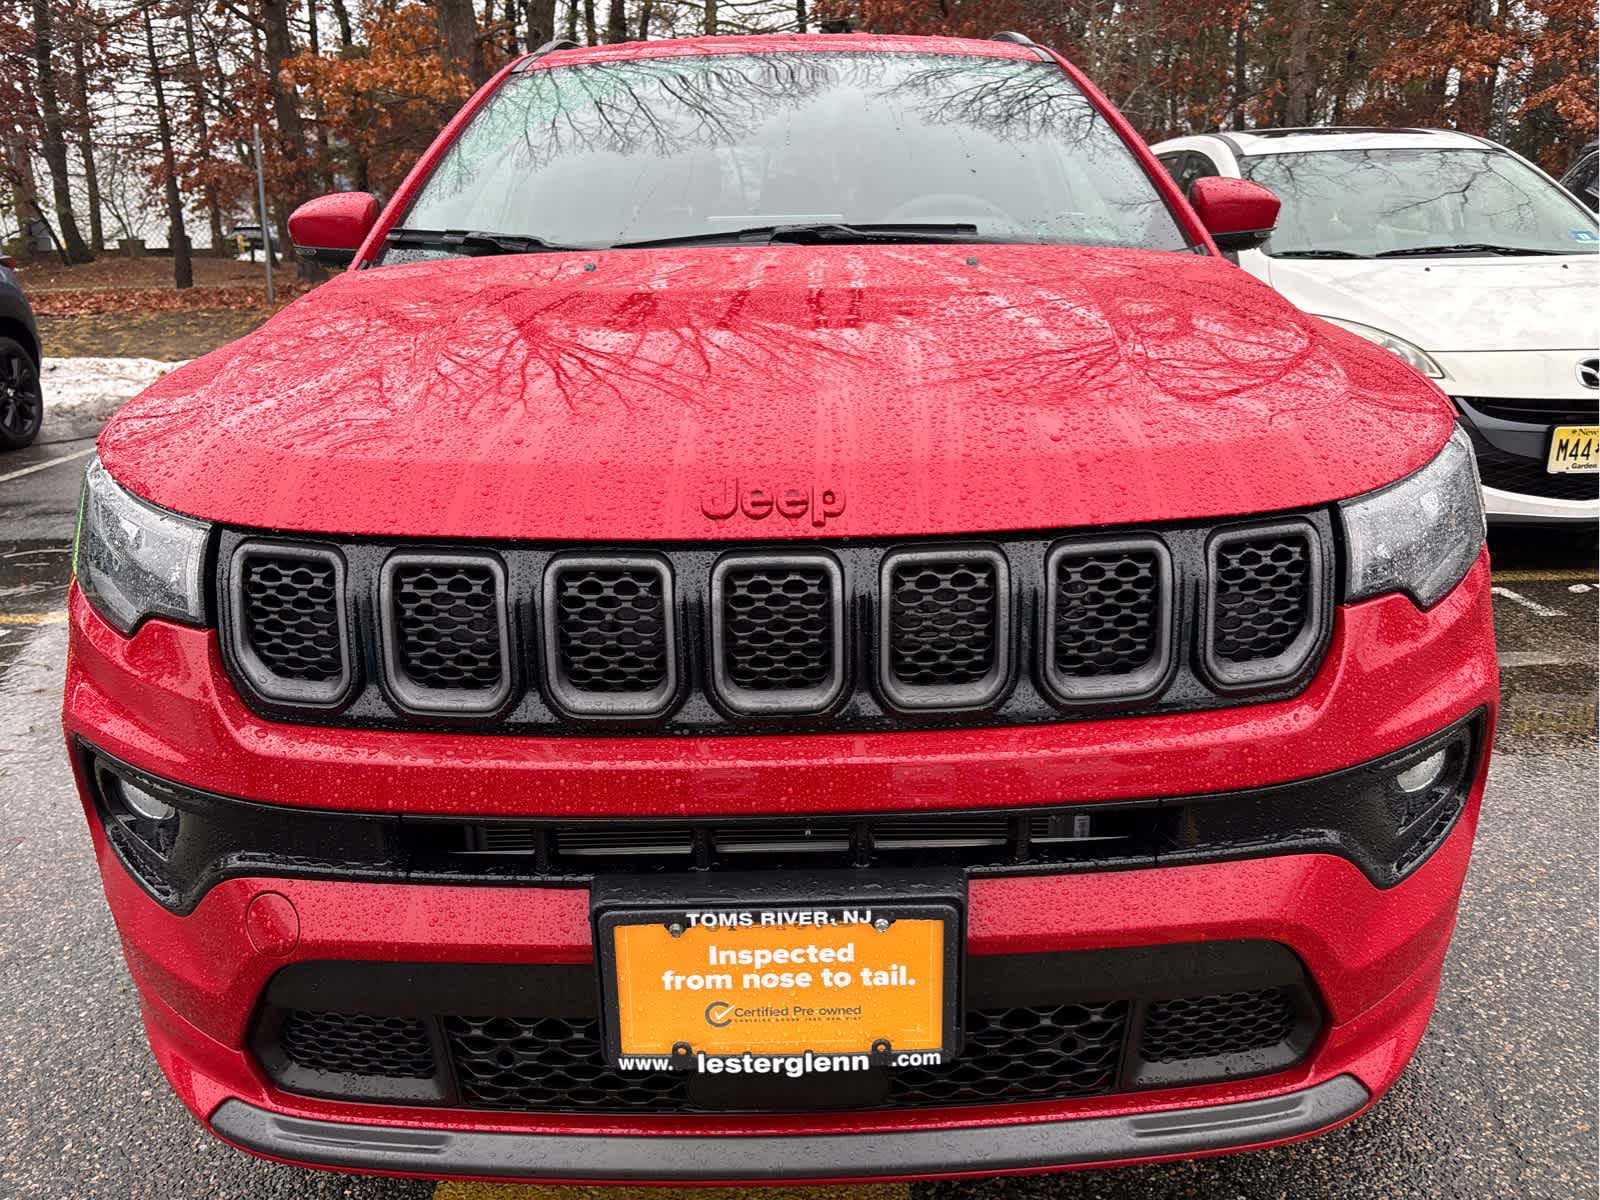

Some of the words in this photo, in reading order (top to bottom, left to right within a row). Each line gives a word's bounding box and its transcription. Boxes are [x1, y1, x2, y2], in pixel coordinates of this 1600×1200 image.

[701, 476, 846, 527] Jeep
[686, 912, 753, 928] TOMS
[843, 910, 872, 925] NJ
[708, 943, 855, 969] Inspected
[661, 970, 733, 990] from
[742, 971, 813, 989] nose
[821, 968, 852, 988] to
[860, 964, 917, 987] tail.
[734, 1006, 789, 1018] Certified
[618, 1057, 674, 1071] www.
[697, 1053, 870, 1078] lesterglenn
[891, 1052, 942, 1067] .com
